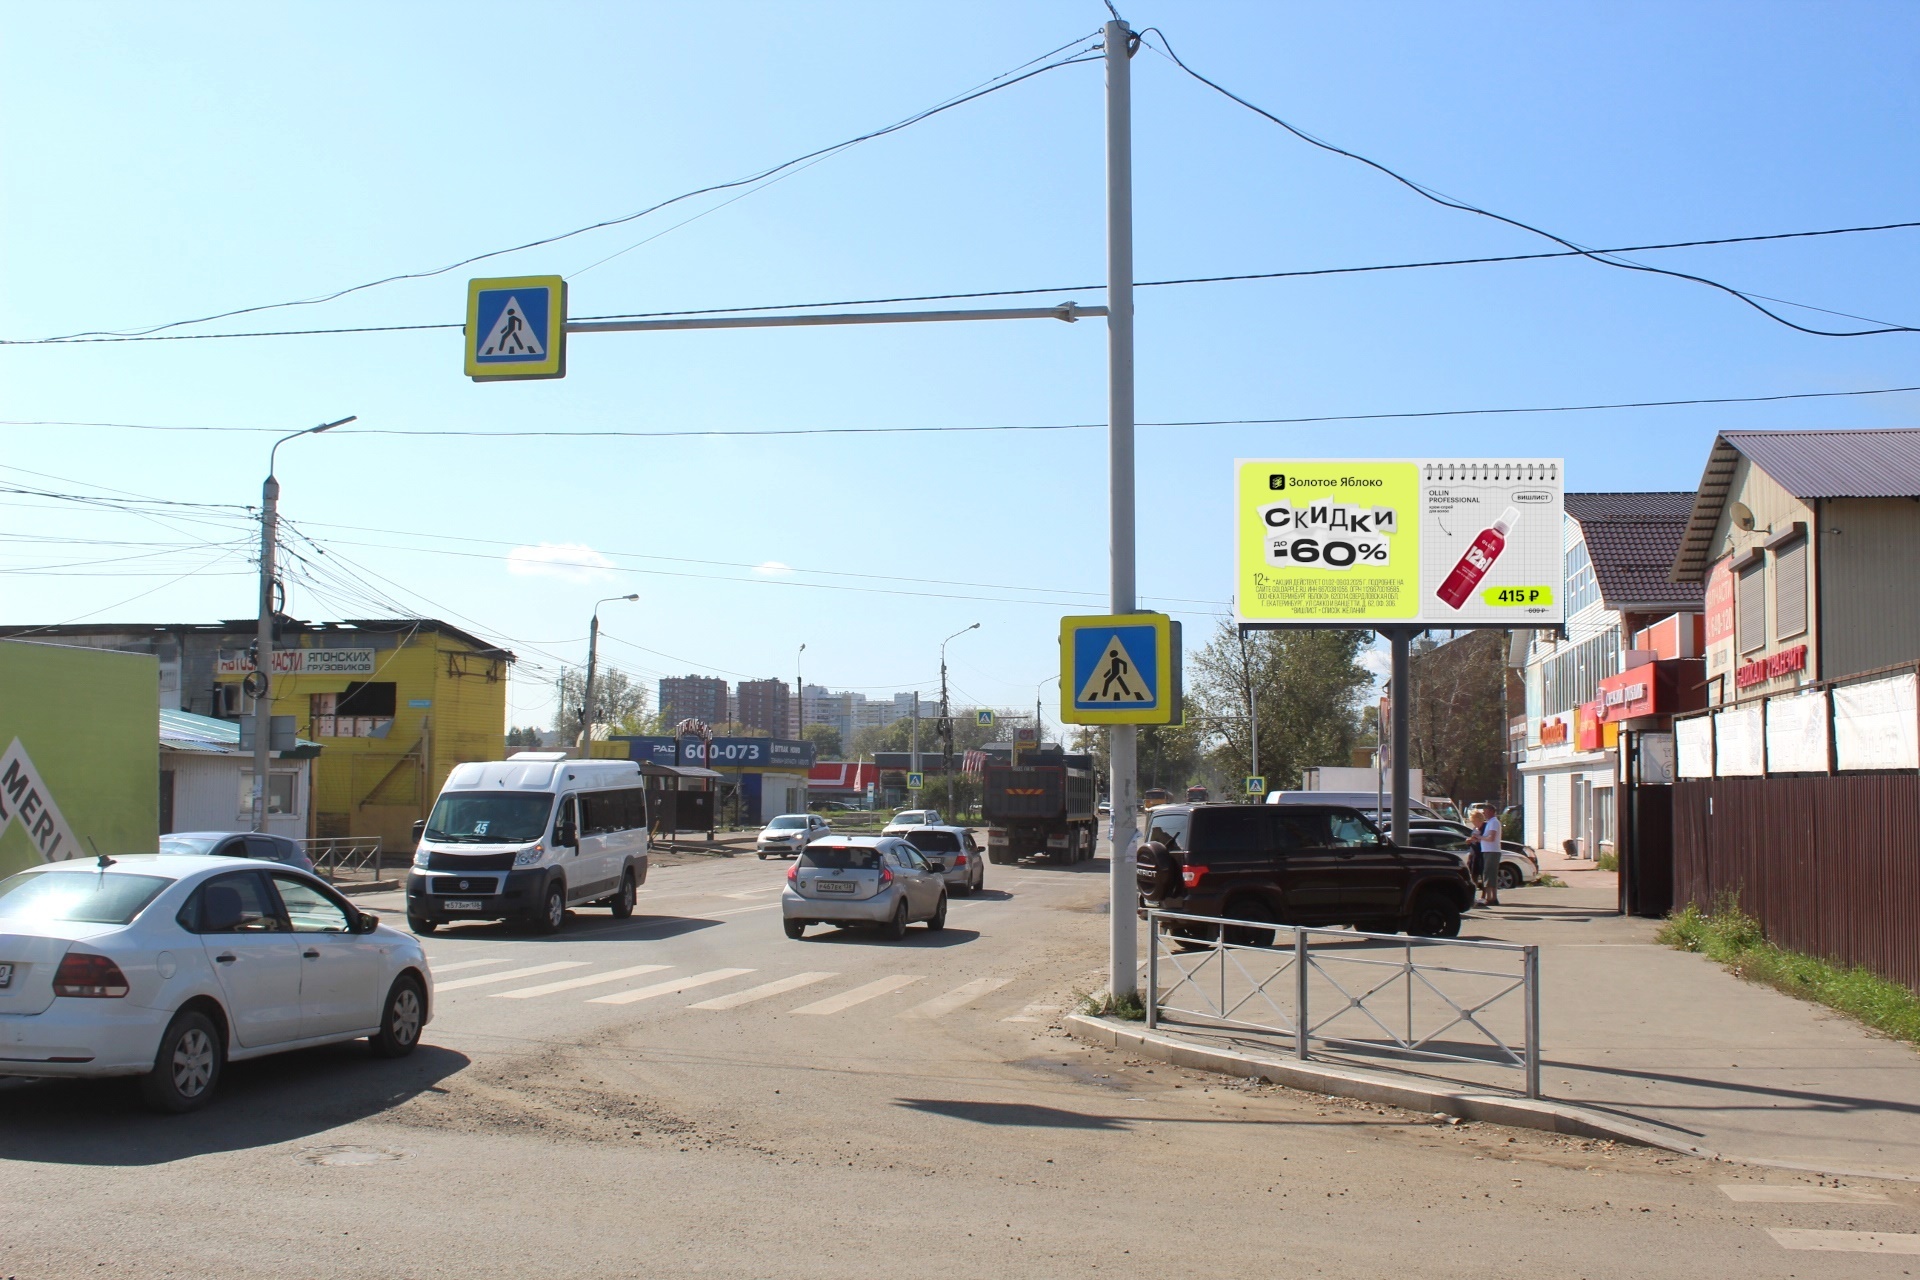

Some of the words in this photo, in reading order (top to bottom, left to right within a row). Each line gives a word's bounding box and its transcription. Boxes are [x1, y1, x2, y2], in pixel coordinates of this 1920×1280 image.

[1289, 477, 1337, 488] Золотое
[1340, 477, 1383, 488] Яблоко
[1253, 572, 1270, 586] 12+
[1498, 590, 1525, 602] 415
[1529, 590, 1539, 602] ₽
[308, 652, 370, 662] ЯПОНСКИХ
[685, 744, 760, 760] 600-073
[1, 758, 73, 862] MERL
[474, 824, 488, 834] 45
